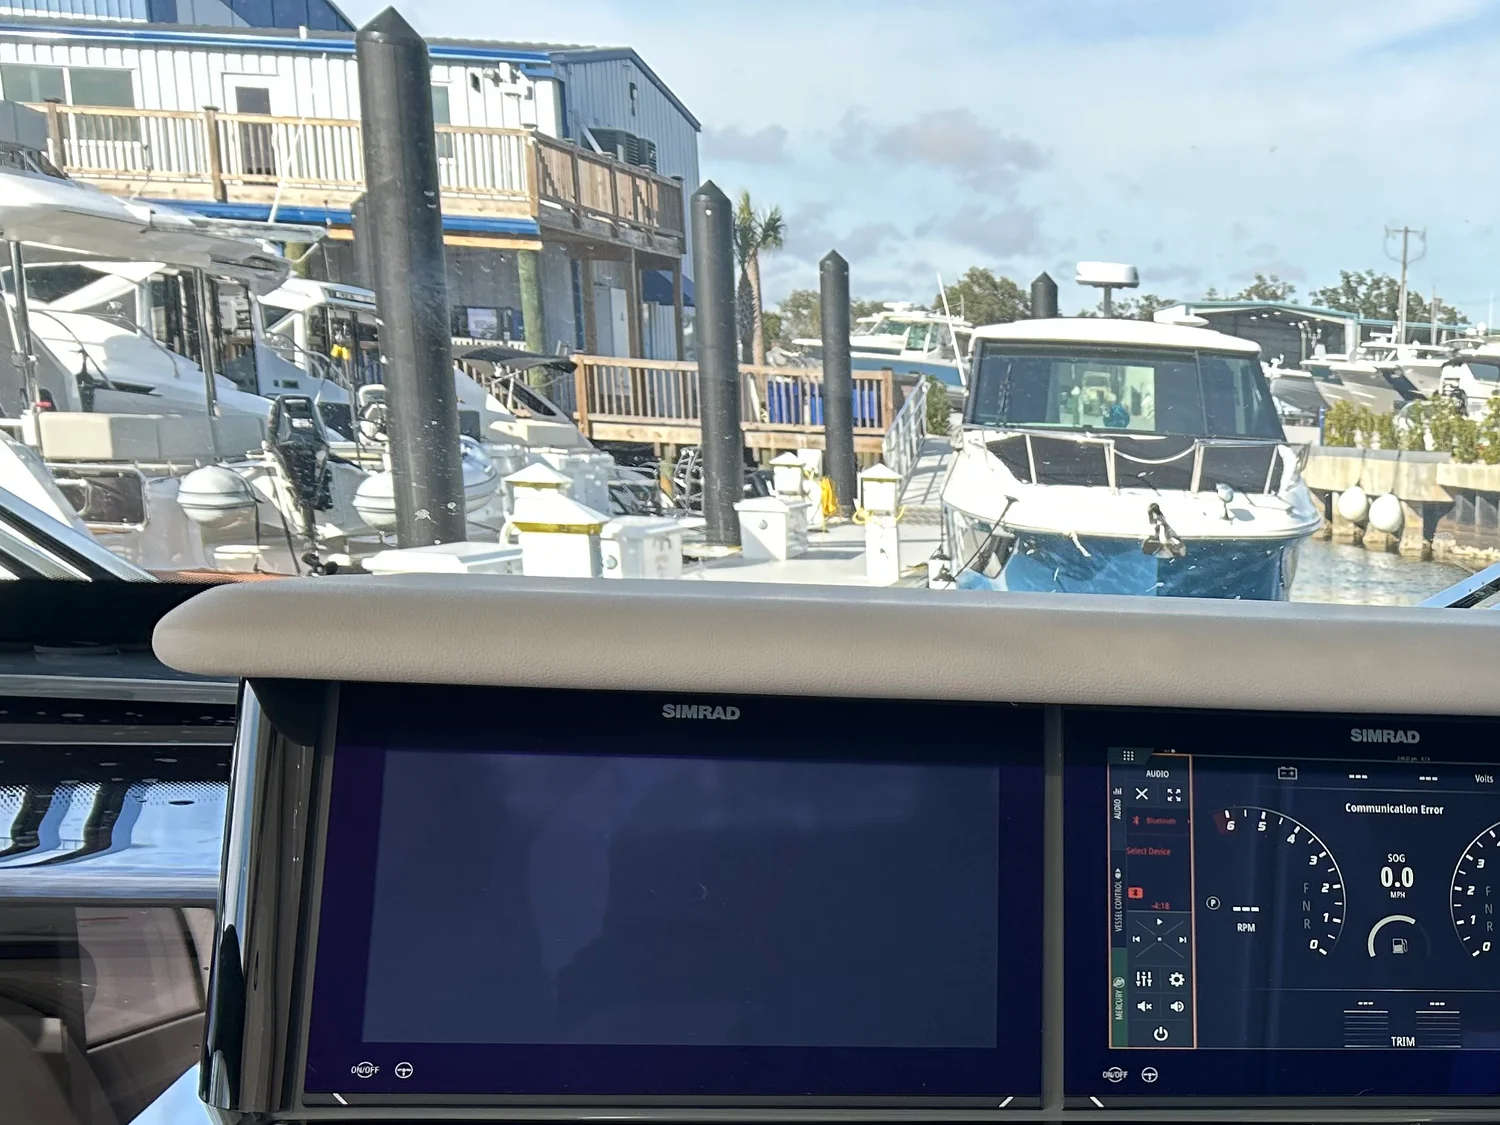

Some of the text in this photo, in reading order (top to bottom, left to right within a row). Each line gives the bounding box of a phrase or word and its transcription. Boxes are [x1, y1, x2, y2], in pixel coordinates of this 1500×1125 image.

[662, 703, 741, 721] SIMRAD
[1350, 728, 1420, 744] SIMRAD
[1145, 769, 1170, 778] AUDIO
[1474, 774, 1494, 783] Volts
[1113, 798, 1122, 820] AUDIO
[1345, 803, 1444, 815] Communication Error
[1126, 847, 1171, 856] Select Device
[1387, 853, 1406, 863] SOG
[1380, 866, 1414, 888] 0.0
[1390, 890, 1406, 899] MPH
[1114, 881, 1123, 932] VESSEL CONTROL
[1237, 922, 1256, 932] RPM
[1115, 990, 1123, 1020] MERCURY
[1391, 1036, 1416, 1047] TRIM
[350, 1064, 380, 1077] ON/OFF
[1102, 1070, 1128, 1079] ON/OFF
